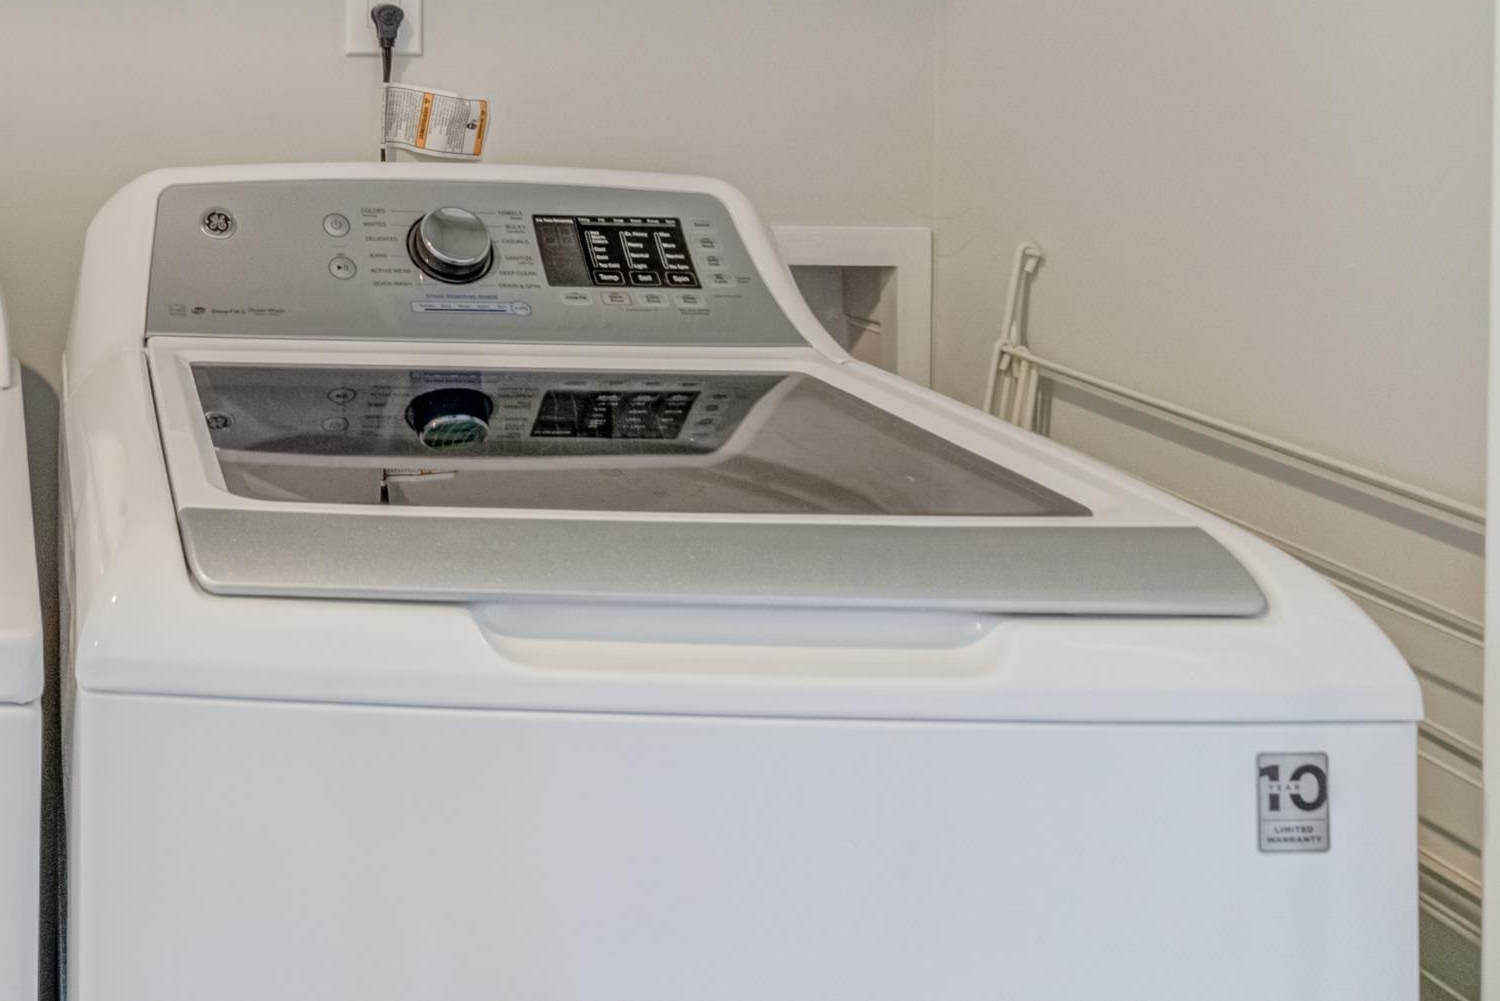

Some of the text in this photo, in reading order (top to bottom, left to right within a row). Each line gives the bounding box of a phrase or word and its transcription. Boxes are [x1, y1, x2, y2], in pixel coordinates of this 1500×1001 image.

[599, 273, 620, 282] Temp
[637, 274, 653, 282] Soil
[672, 274, 691, 283] Spin
[1259, 764, 1328, 812] 10
[1269, 784, 1301, 792] YEAR
[1274, 826, 1314, 834] LIMITED
[1266, 836, 1322, 844] WARRANTY
